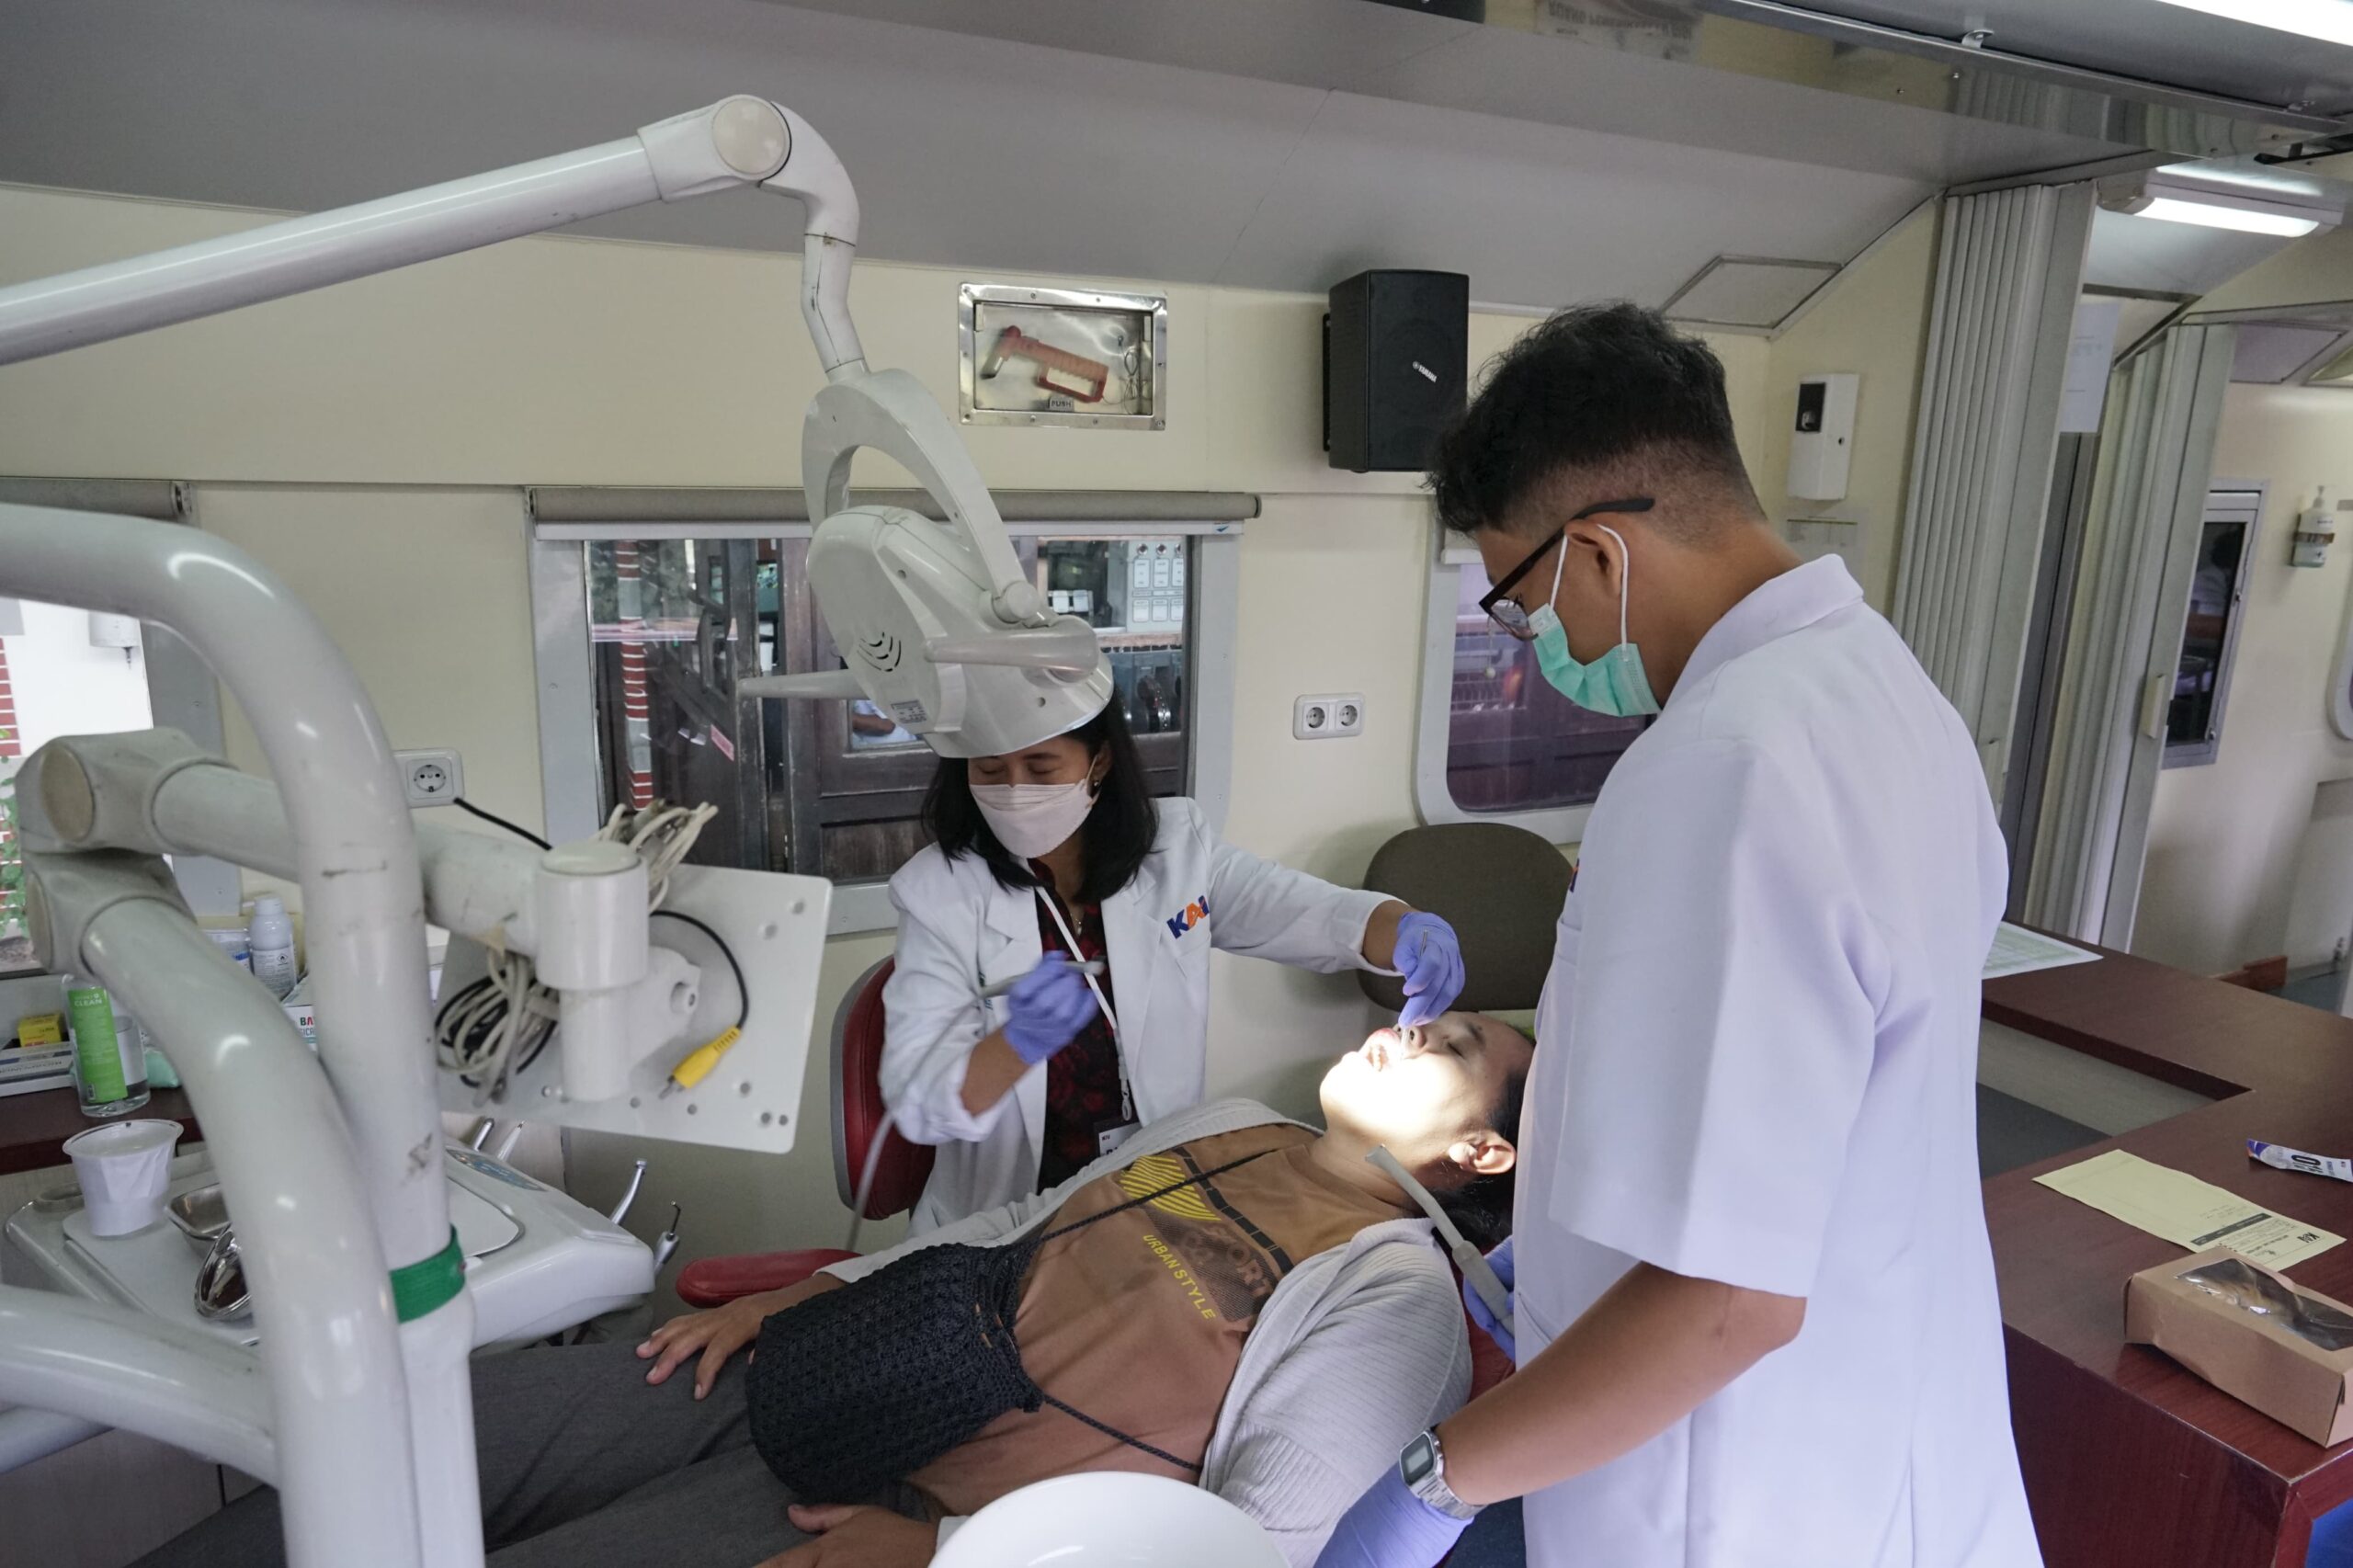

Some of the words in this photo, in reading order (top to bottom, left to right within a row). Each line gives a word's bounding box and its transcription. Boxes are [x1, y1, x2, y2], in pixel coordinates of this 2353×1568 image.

[1166, 895, 1210, 939] KAI
[74, 998, 103, 1007] CLEAN
[1142, 1234, 1180, 1269] URBAN
[1173, 1268, 1216, 1319] STYLE
